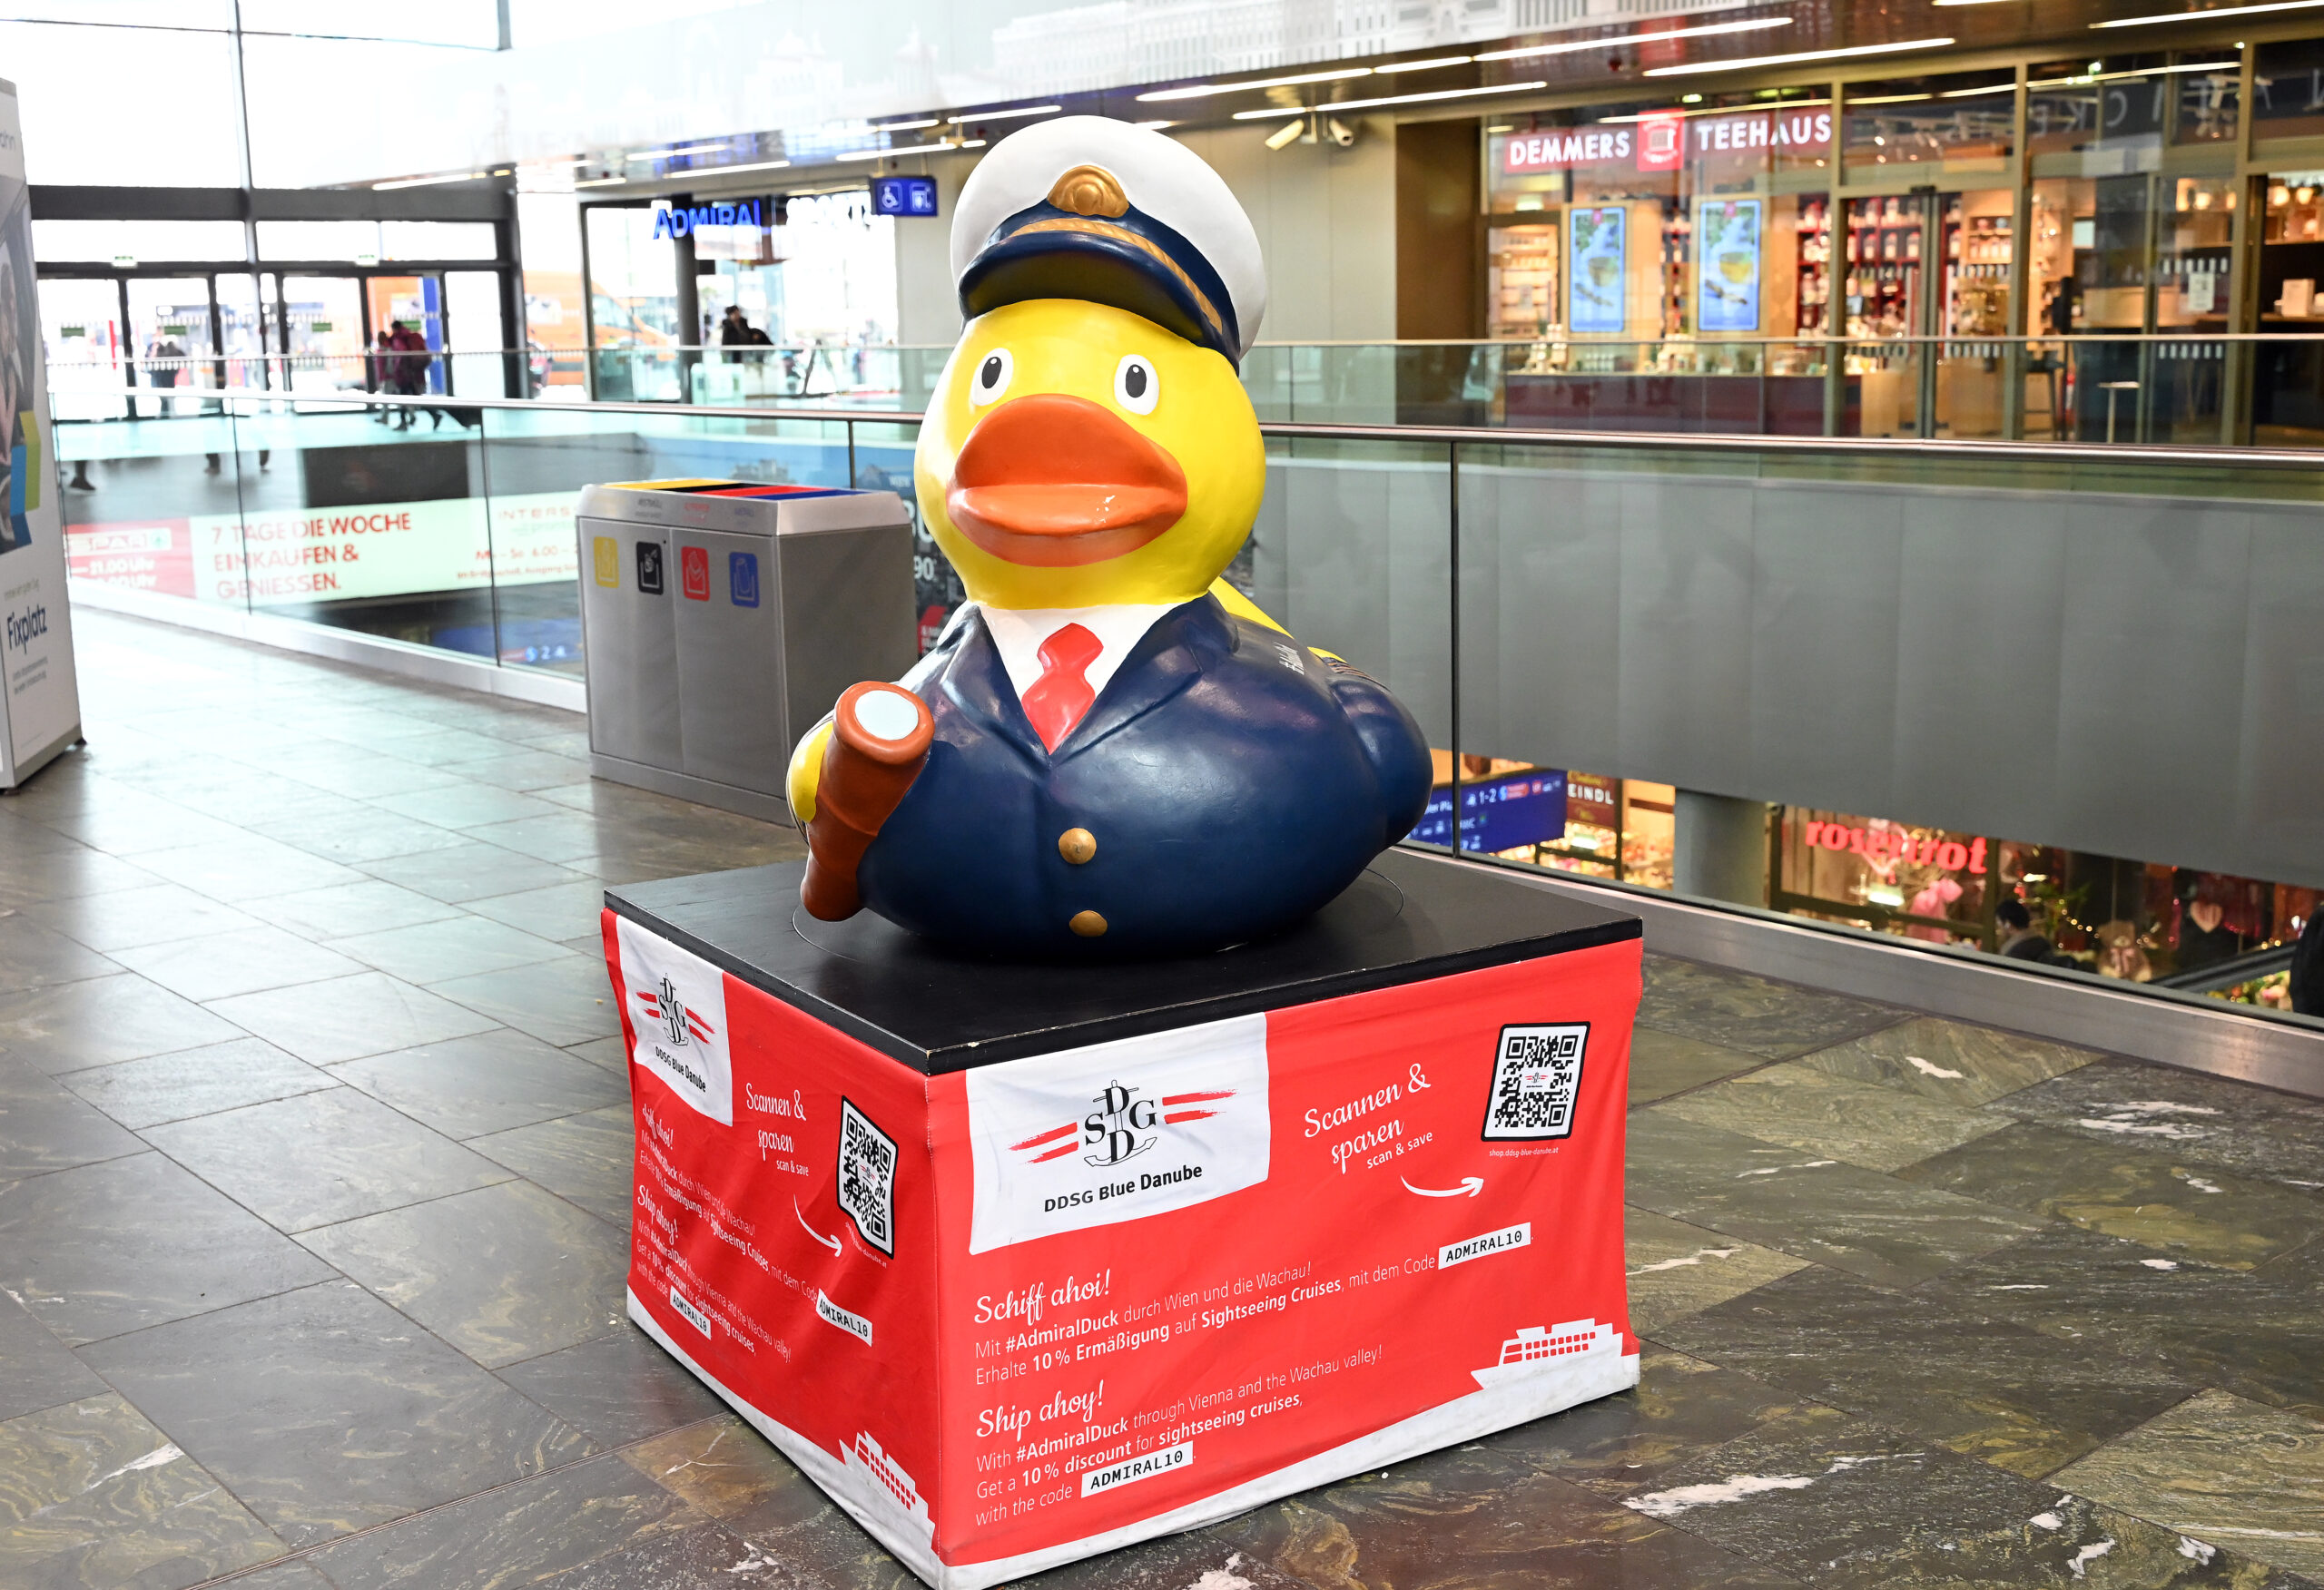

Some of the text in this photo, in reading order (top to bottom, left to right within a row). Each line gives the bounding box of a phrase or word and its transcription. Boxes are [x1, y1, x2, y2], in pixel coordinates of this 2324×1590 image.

[1510, 132, 1630, 166] DEMMERS
[1696, 114, 1832, 152] TEEHAUS
[212, 513, 411, 545] 7 TAGE DIE WOCHE
[214, 543, 359, 572] EINKAUFEN &
[6, 604, 48, 654] Fixplatz
[1567, 783, 1615, 806] EINDL
[1805, 820, 1988, 875] rosenrot
[655, 1045, 706, 1093] DDSG Blue Danube
[745, 1082, 807, 1122] Scannen &
[1304, 1063, 1432, 1138] Scannen &
[757, 1128, 795, 1162] sparen
[776, 1159, 809, 1177] scan & save
[1330, 1118, 1404, 1174] sparen
[1366, 1132, 1433, 1169] scan & save
[637, 1184, 656, 1225] Ship
[678, 1171, 694, 1192] durch
[1044, 1164, 1204, 1212] DDSG Blue Danube
[636, 1261, 648, 1280] with
[647, 1268, 657, 1287] the
[656, 1279, 669, 1299] code
[636, 1239, 647, 1260] Get
[665, 1263, 688, 1296] discount
[694, 1295, 731, 1337] sightseeing
[637, 1218, 651, 1240] With
[705, 1280, 727, 1308] Vienna
[727, 1299, 737, 1318] and
[737, 1308, 747, 1328] the
[746, 1314, 773, 1346] Wachau
[773, 1337, 792, 1364] valley!
[747, 1242, 771, 1276] Cruises,
[771, 1265, 783, 1282] mit
[783, 1270, 800, 1291] dem
[801, 1281, 818, 1305] Code
[973, 1268, 1111, 1327] Schiff ahoi!
[975, 1261, 1312, 1359] Mit #AdmiralDuck durch Wien und die Wachau!
[976, 1359, 1028, 1385] Erhalte
[1075, 1323, 1170, 1361] Ermäßigung
[1174, 1313, 1197, 1336] auf
[1201, 1292, 1287, 1330] Sightseeing
[1290, 1278, 1345, 1304] Cruises,
[1348, 1270, 1370, 1289] mit
[1372, 1262, 1400, 1282] dem
[1403, 1254, 1436, 1275] Code
[975, 1379, 1105, 1442] Ship ahoy!
[976, 1344, 1383, 1473] With #AdmiralDuck through Vienna and the Wachau valley!
[977, 1479, 1003, 1499] Get
[1007, 1477, 1016, 1491] a
[1065, 1442, 1132, 1474] discount
[1136, 1434, 1156, 1452] for
[1158, 1406, 1246, 1446] sightseeing
[1249, 1391, 1304, 1418] cruises,
[975, 1505, 1008, 1526] with
[1012, 1497, 1035, 1516] the
[1039, 1485, 1073, 1507] code
